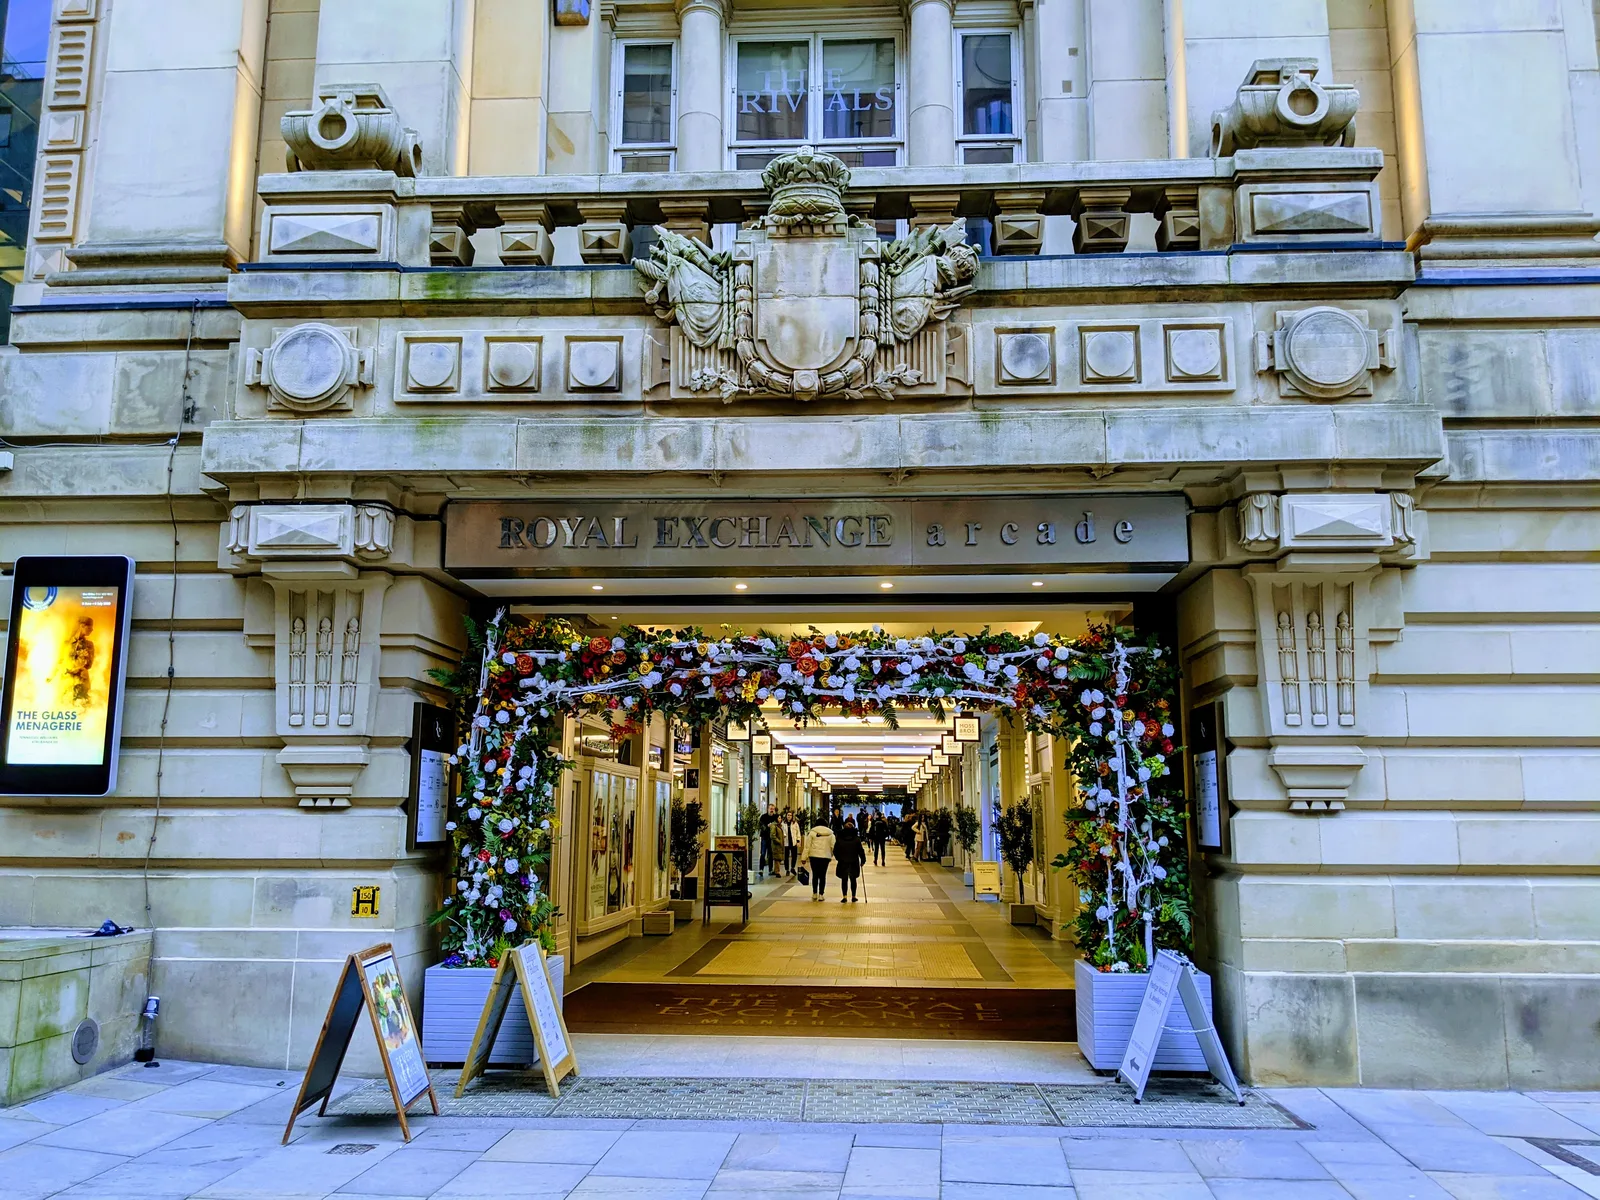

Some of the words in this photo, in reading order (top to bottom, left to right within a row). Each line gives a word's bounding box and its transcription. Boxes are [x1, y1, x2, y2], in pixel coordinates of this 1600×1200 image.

[756, 68, 846, 92] THE
[740, 87, 893, 113] RIVALS
[498, 515, 638, 549] ROYAL
[652, 515, 893, 549] EXCHANGE
[926, 511, 1134, 546] arcade
[17, 711, 38, 720] THE
[41, 711, 77, 720] GLASS
[16, 721, 82, 731] MENAGERIE
[361, 892, 371, 900] 150
[361, 906, 369, 914] 10
[673, 997, 778, 1007] THE
[804, 999, 997, 1011] ROYAL
[659, 1006, 1002, 1021] EXCHANGE
